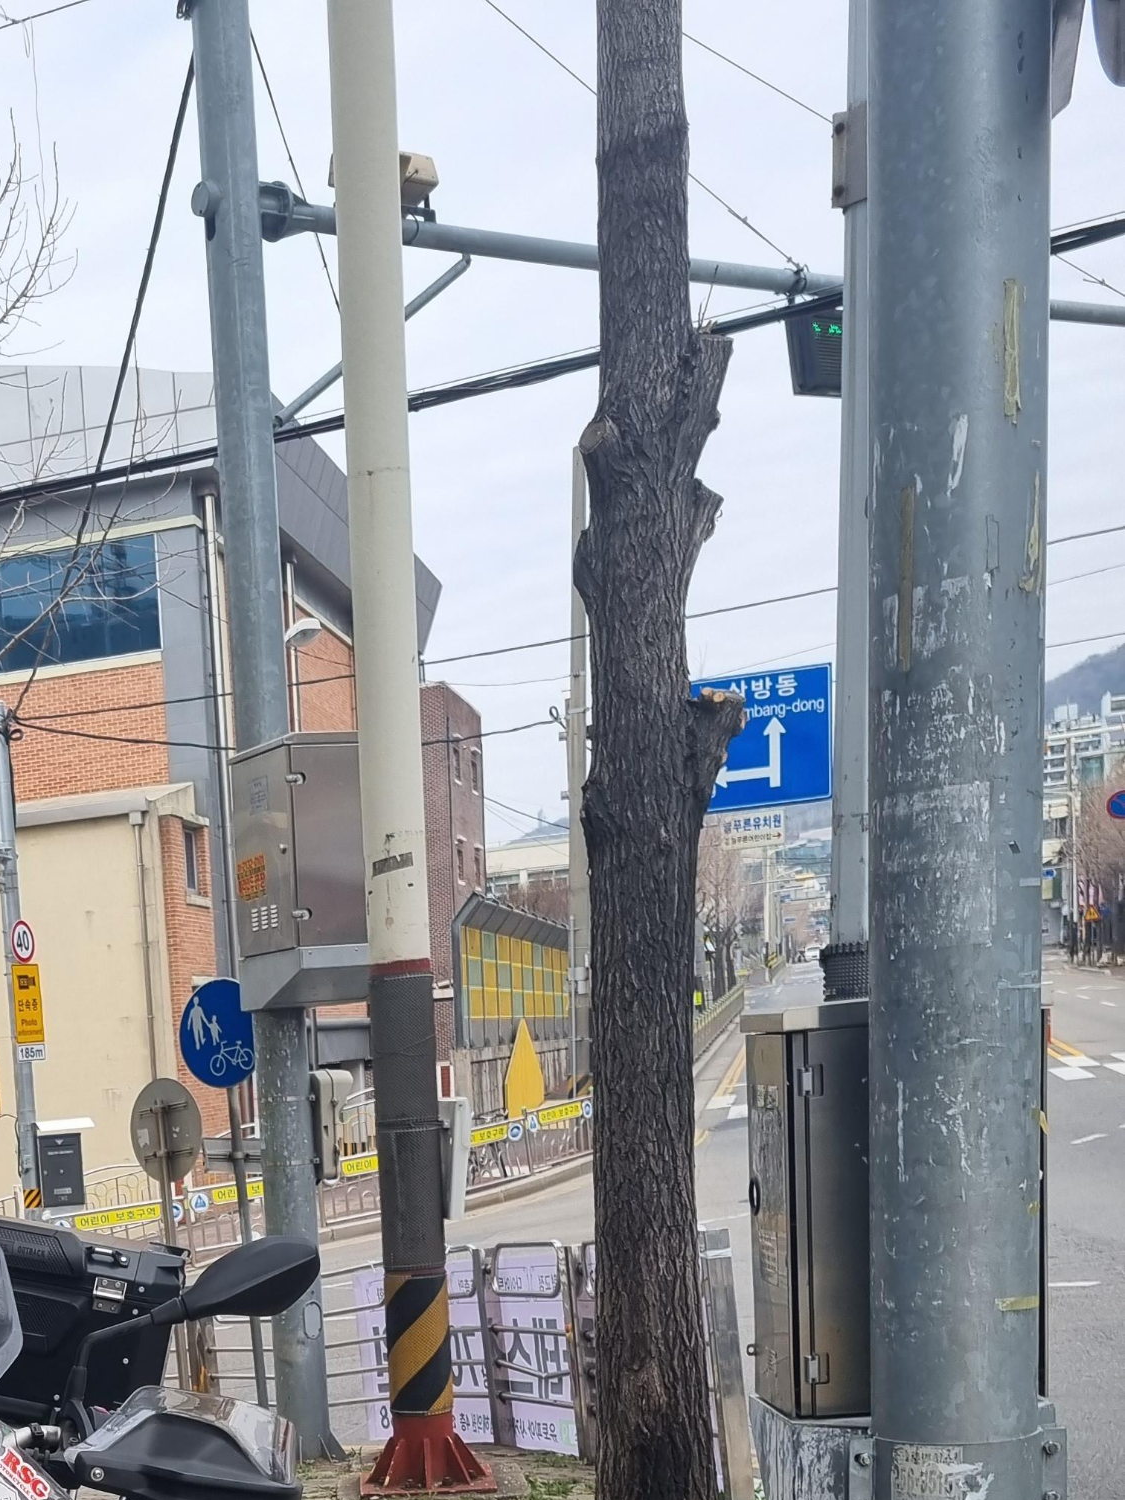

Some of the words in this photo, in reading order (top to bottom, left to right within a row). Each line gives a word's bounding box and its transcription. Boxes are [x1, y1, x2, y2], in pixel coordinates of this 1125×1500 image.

[16, 931, 30, 952] 40
[17, 998, 38, 1012] 단속중
[21, 1018, 38, 1027] Photo
[19, 1047, 44, 1059] 185m
[345, 1161, 373, 1172] 어린이
[217, 1189, 236, 1200] 어린
[79, 1214, 110, 1227] 어린이
[116, 1206, 157, 1221] 보호구역
[0, 1449, 48, 1498] RSG
